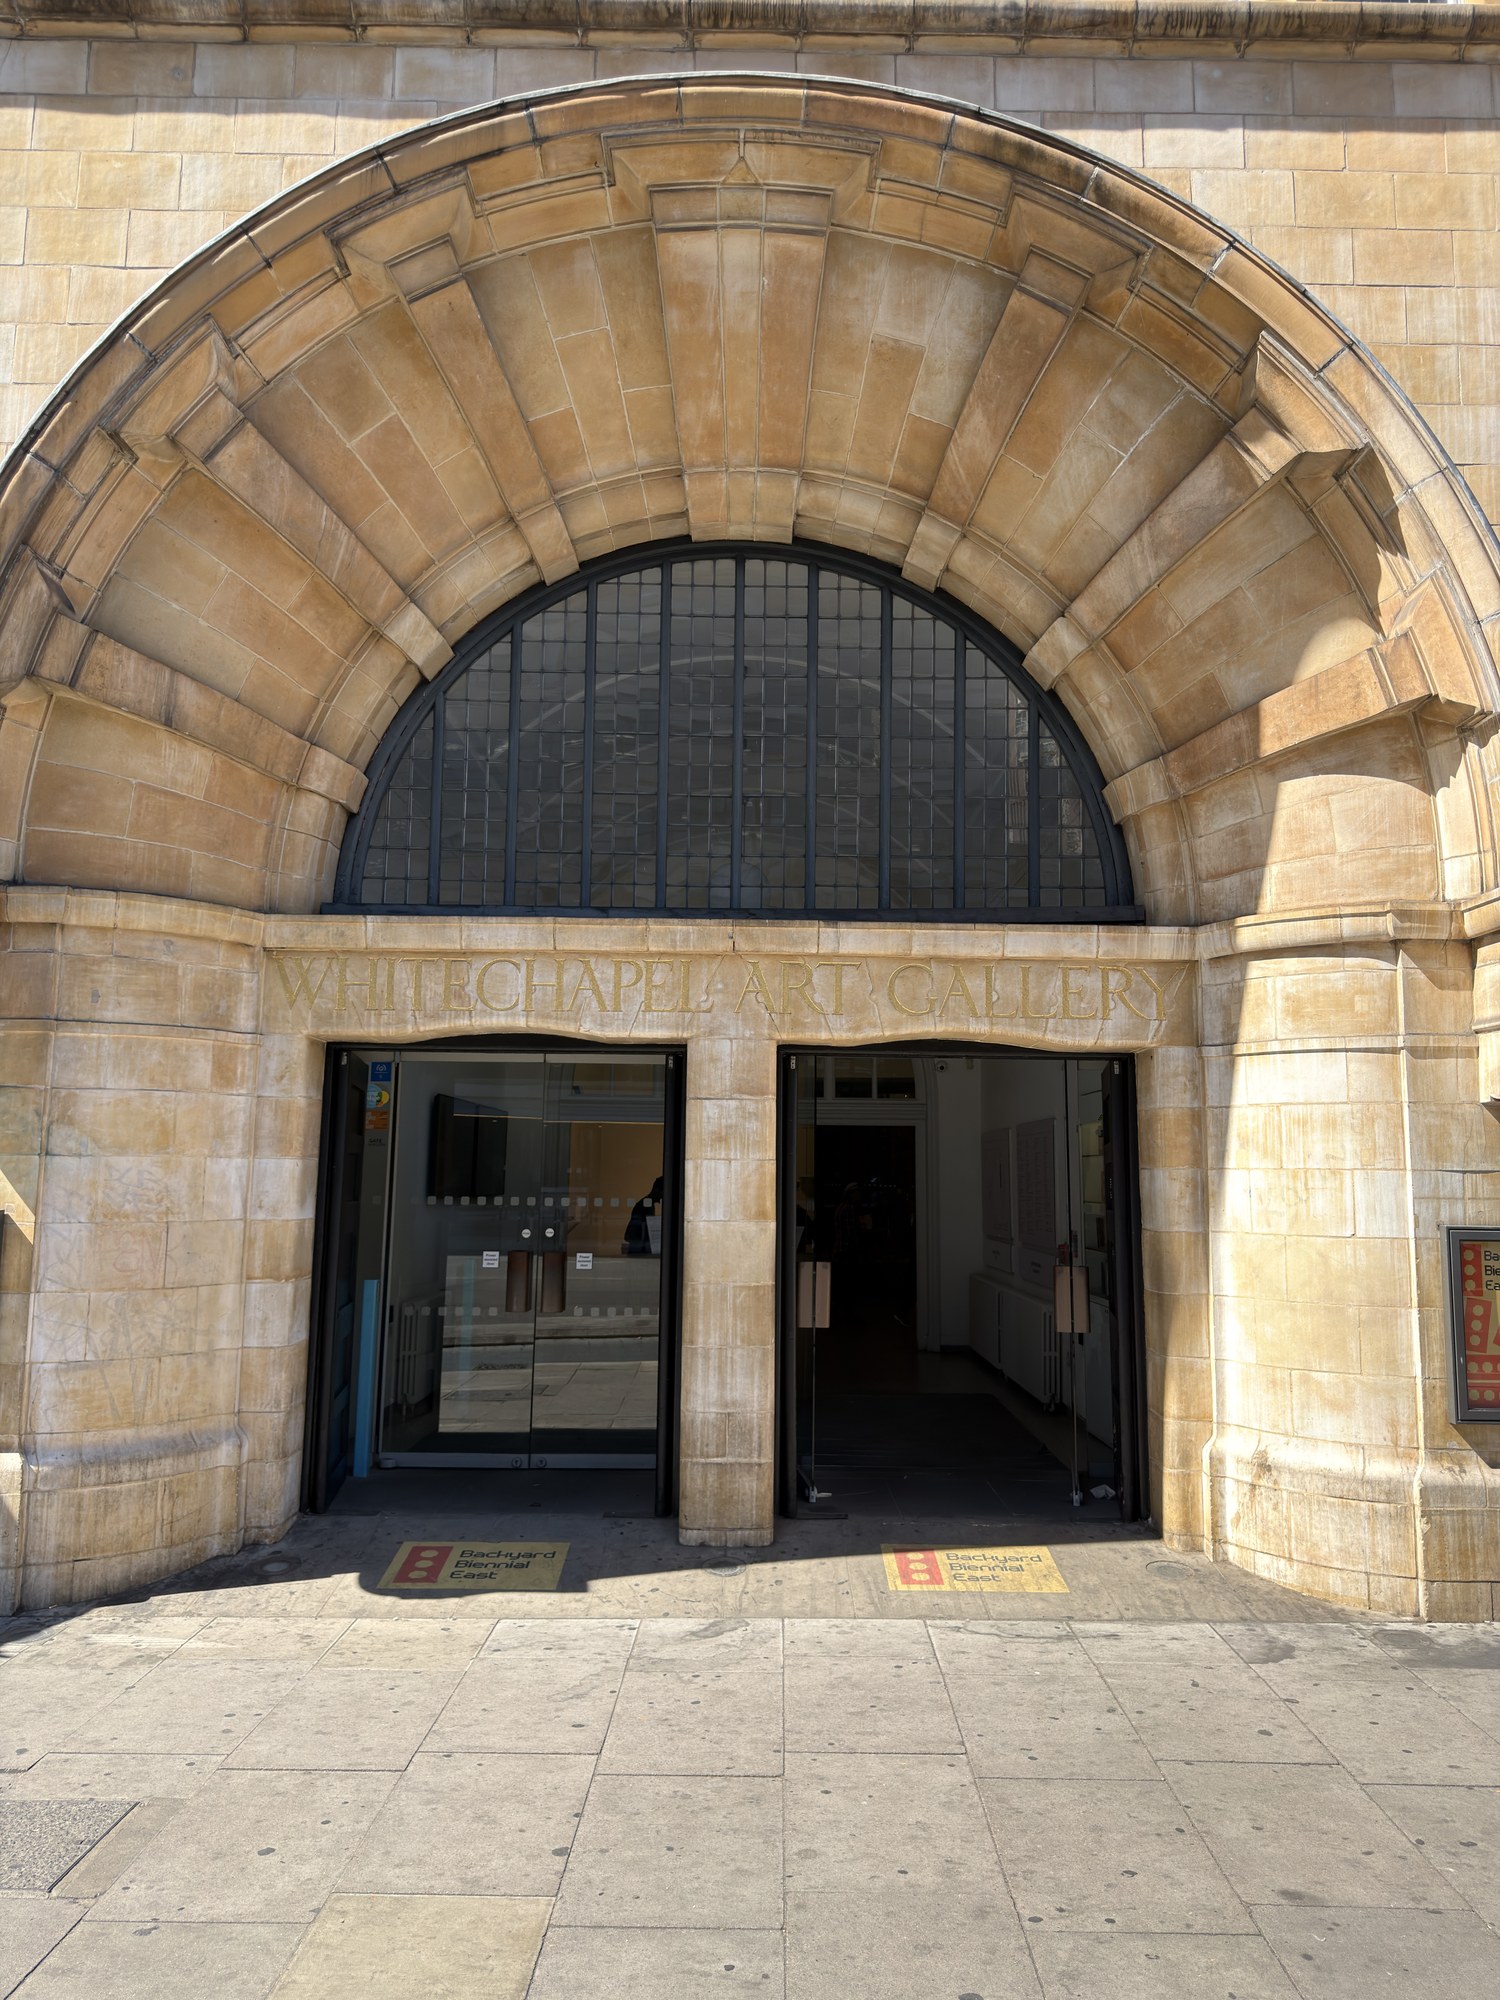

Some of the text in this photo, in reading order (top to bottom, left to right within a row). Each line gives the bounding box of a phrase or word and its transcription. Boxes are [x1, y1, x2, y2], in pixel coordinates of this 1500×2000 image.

[272, 955, 1189, 1022] WHITECHAPEL ART GALLERY
[1484, 1250, 1500, 1261] Ba
[459, 1549, 557, 1560] Backyard
[945, 1552, 1043, 1563] Backyard
[454, 1560, 530, 1569] Biennial
[949, 1562, 1025, 1572] Biennial
[450, 1570, 498, 1580] East
[953, 1572, 1002, 1582] East
